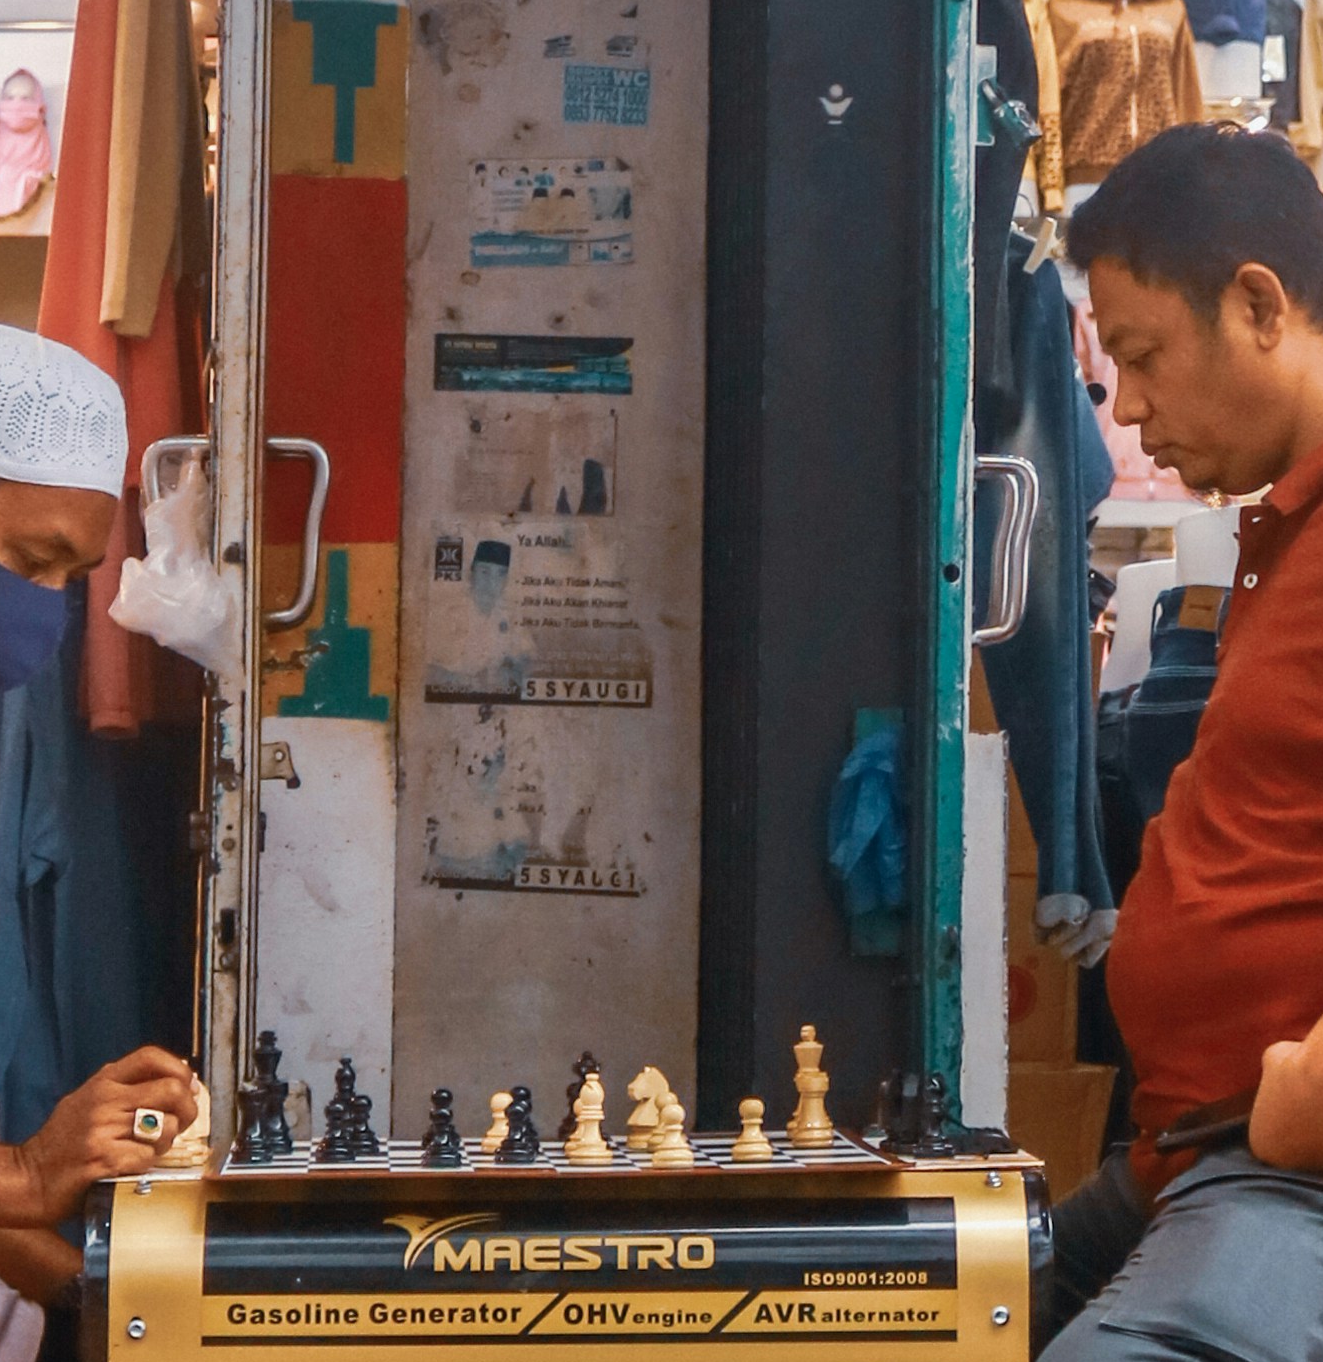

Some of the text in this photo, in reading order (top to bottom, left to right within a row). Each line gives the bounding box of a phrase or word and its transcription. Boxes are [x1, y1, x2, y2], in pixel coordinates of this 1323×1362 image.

[614, 70, 648, 87] WC
[517, 534, 532, 547] Ya
[434, 570, 462, 582] PKS
[527, 681, 536, 697] 5
[545, 681, 641, 700] SYAUGI
[520, 867, 530, 884] 5
[433, 1237, 715, 1272] MAESTRO
[803, 1271, 928, 1286] ISO9001:2008
[227, 1302, 940, 1328] Gasoline Generator OHV engine AVR alternator
